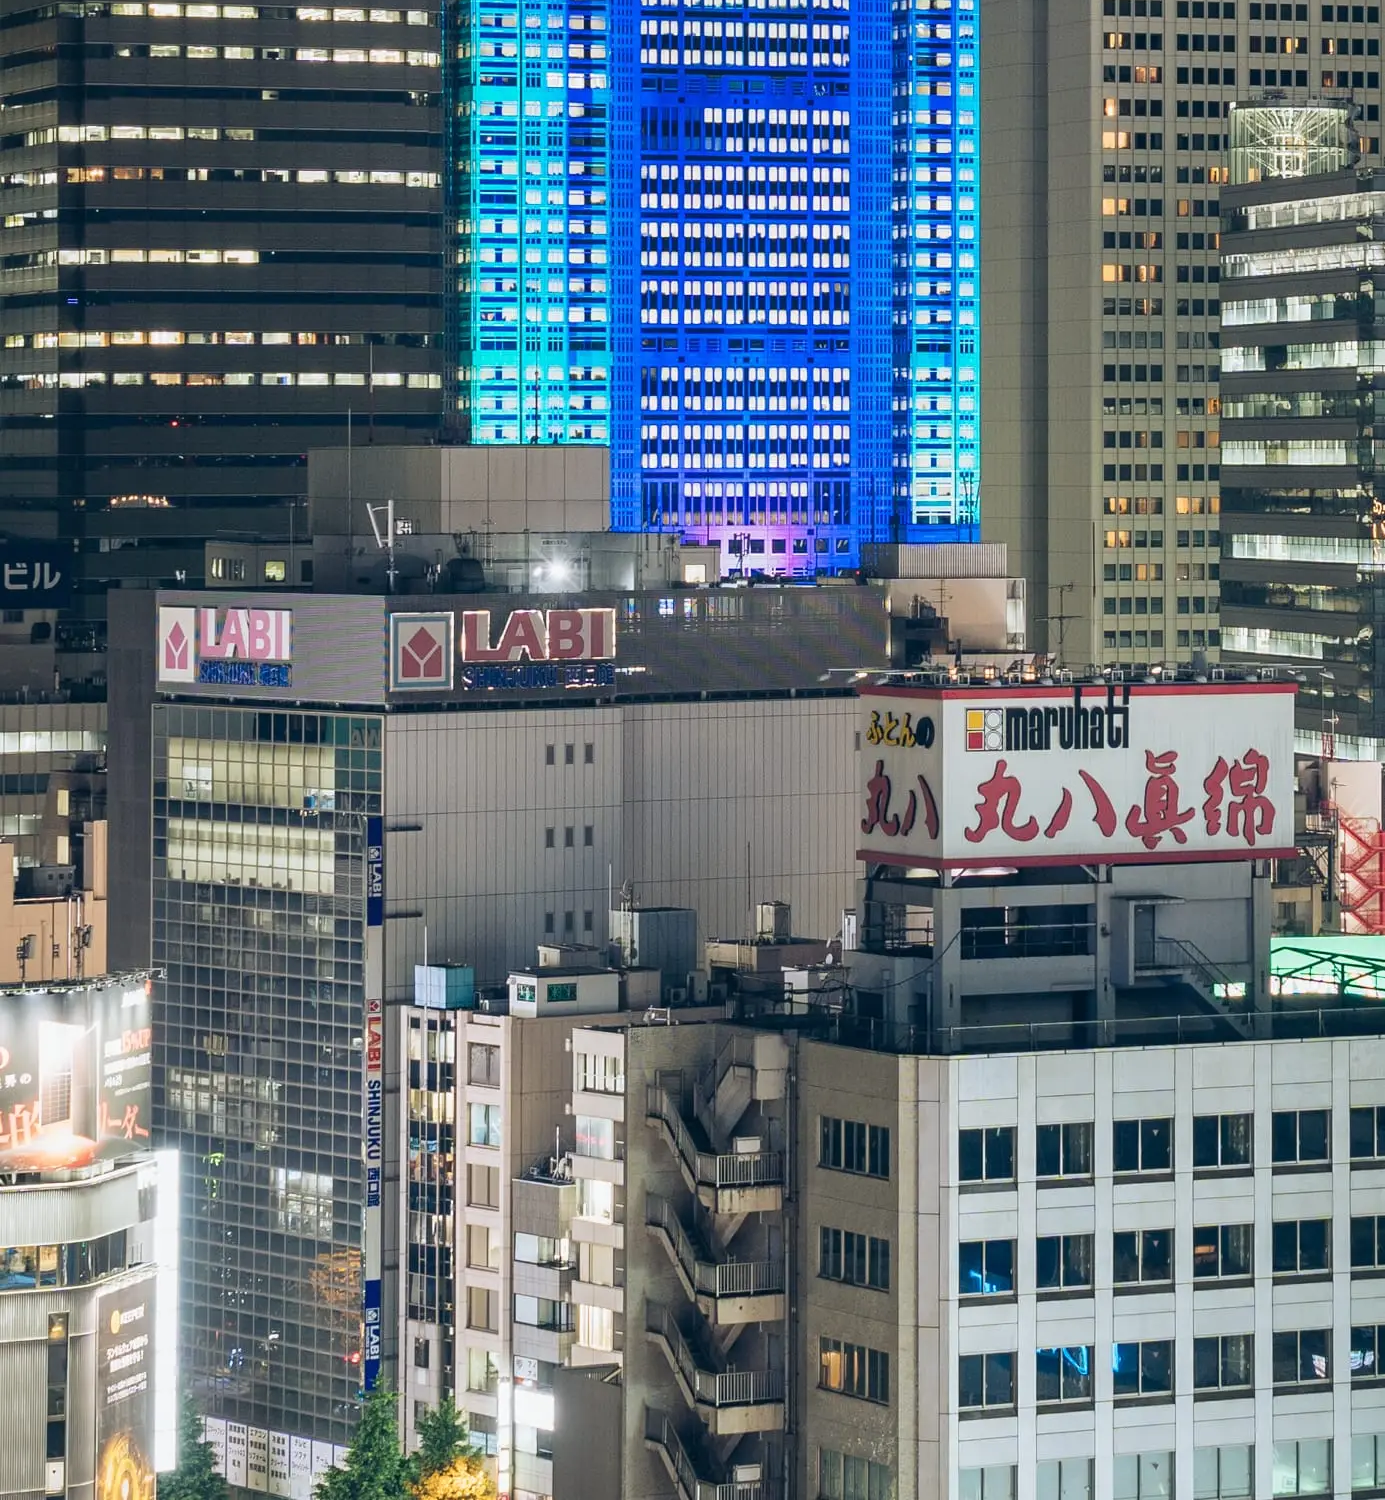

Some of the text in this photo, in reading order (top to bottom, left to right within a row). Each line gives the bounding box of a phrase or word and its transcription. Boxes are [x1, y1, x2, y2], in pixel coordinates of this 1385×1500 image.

[4, 562, 61, 590] ビル
[201, 608, 291, 660] LABI
[462, 608, 616, 662] LABI
[866, 710, 936, 749] ふとんの
[1006, 685, 1130, 751] maruhati
[862, 759, 940, 841] 丸八
[372, 863, 382, 898] LABI
[367, 1016, 381, 1208] LABI SHINJUKU 西口館
[370, 1324, 380, 1360] LABI
